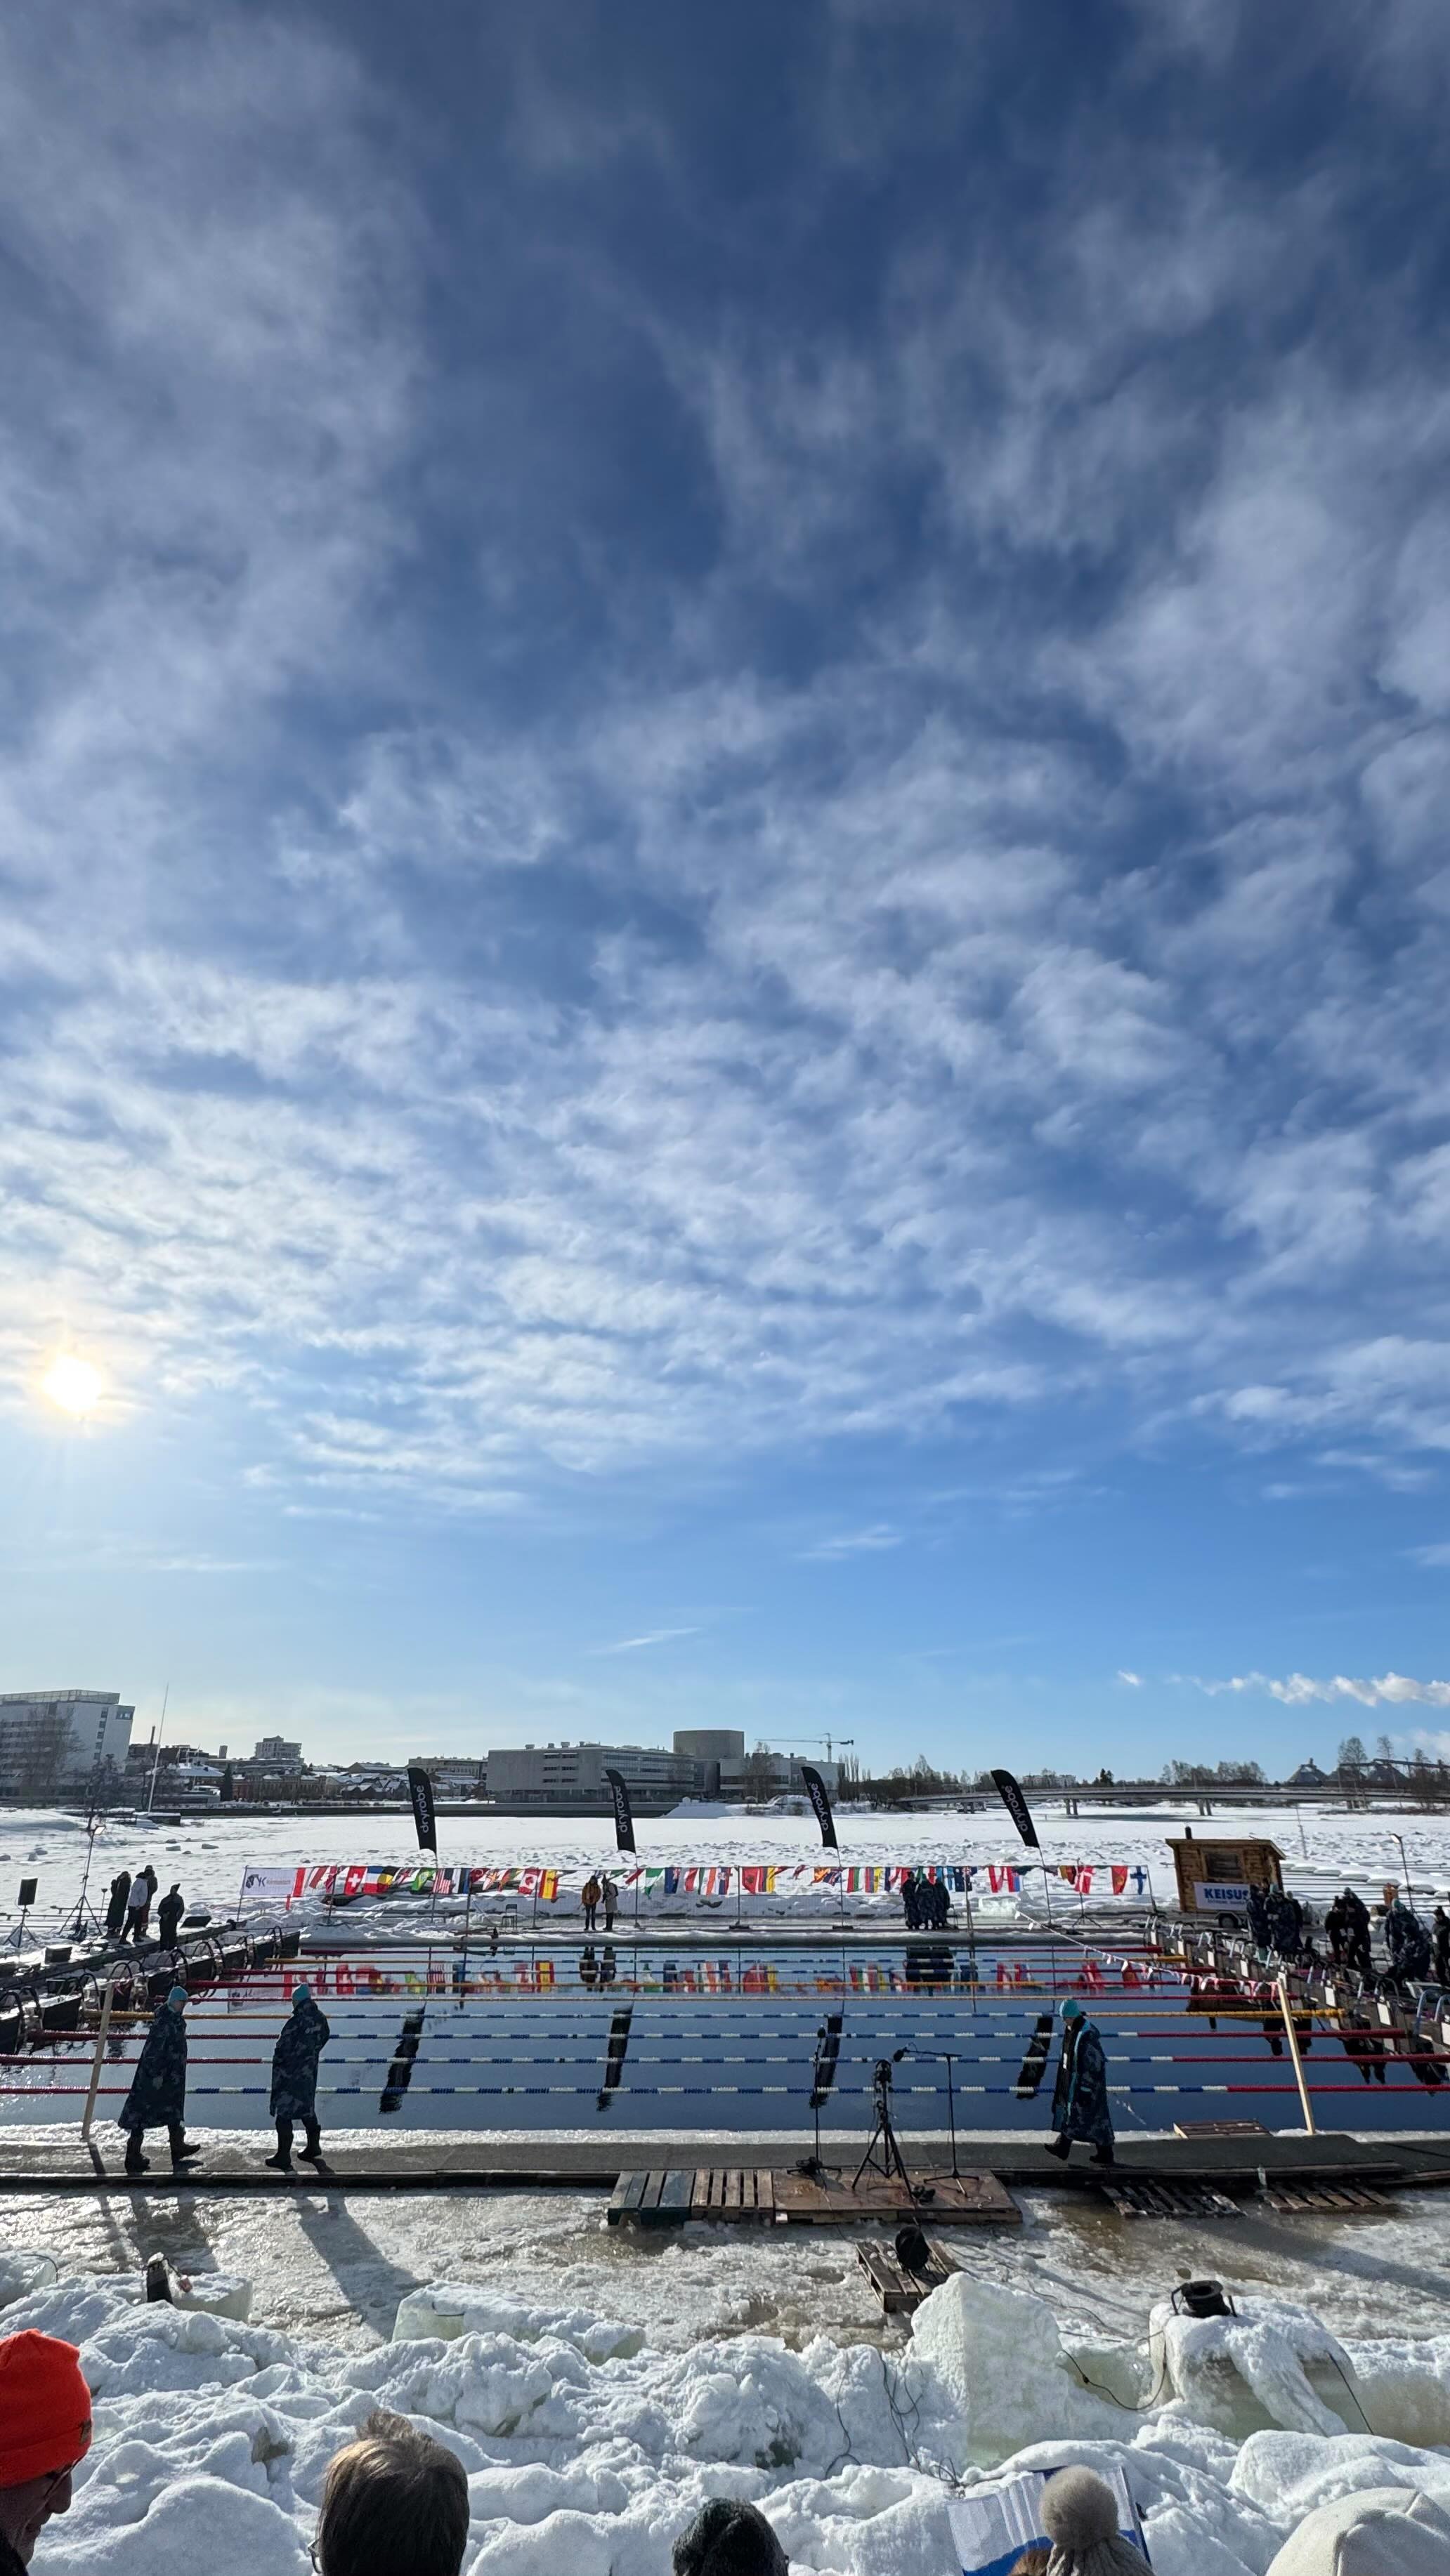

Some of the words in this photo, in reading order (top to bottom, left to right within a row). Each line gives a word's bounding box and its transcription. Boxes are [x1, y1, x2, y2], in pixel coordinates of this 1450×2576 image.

[416, 1785, 430, 1833] dryrobe
[811, 1783, 829, 1831] dryrobe
[1005, 1785, 1028, 1832] dryrobe
